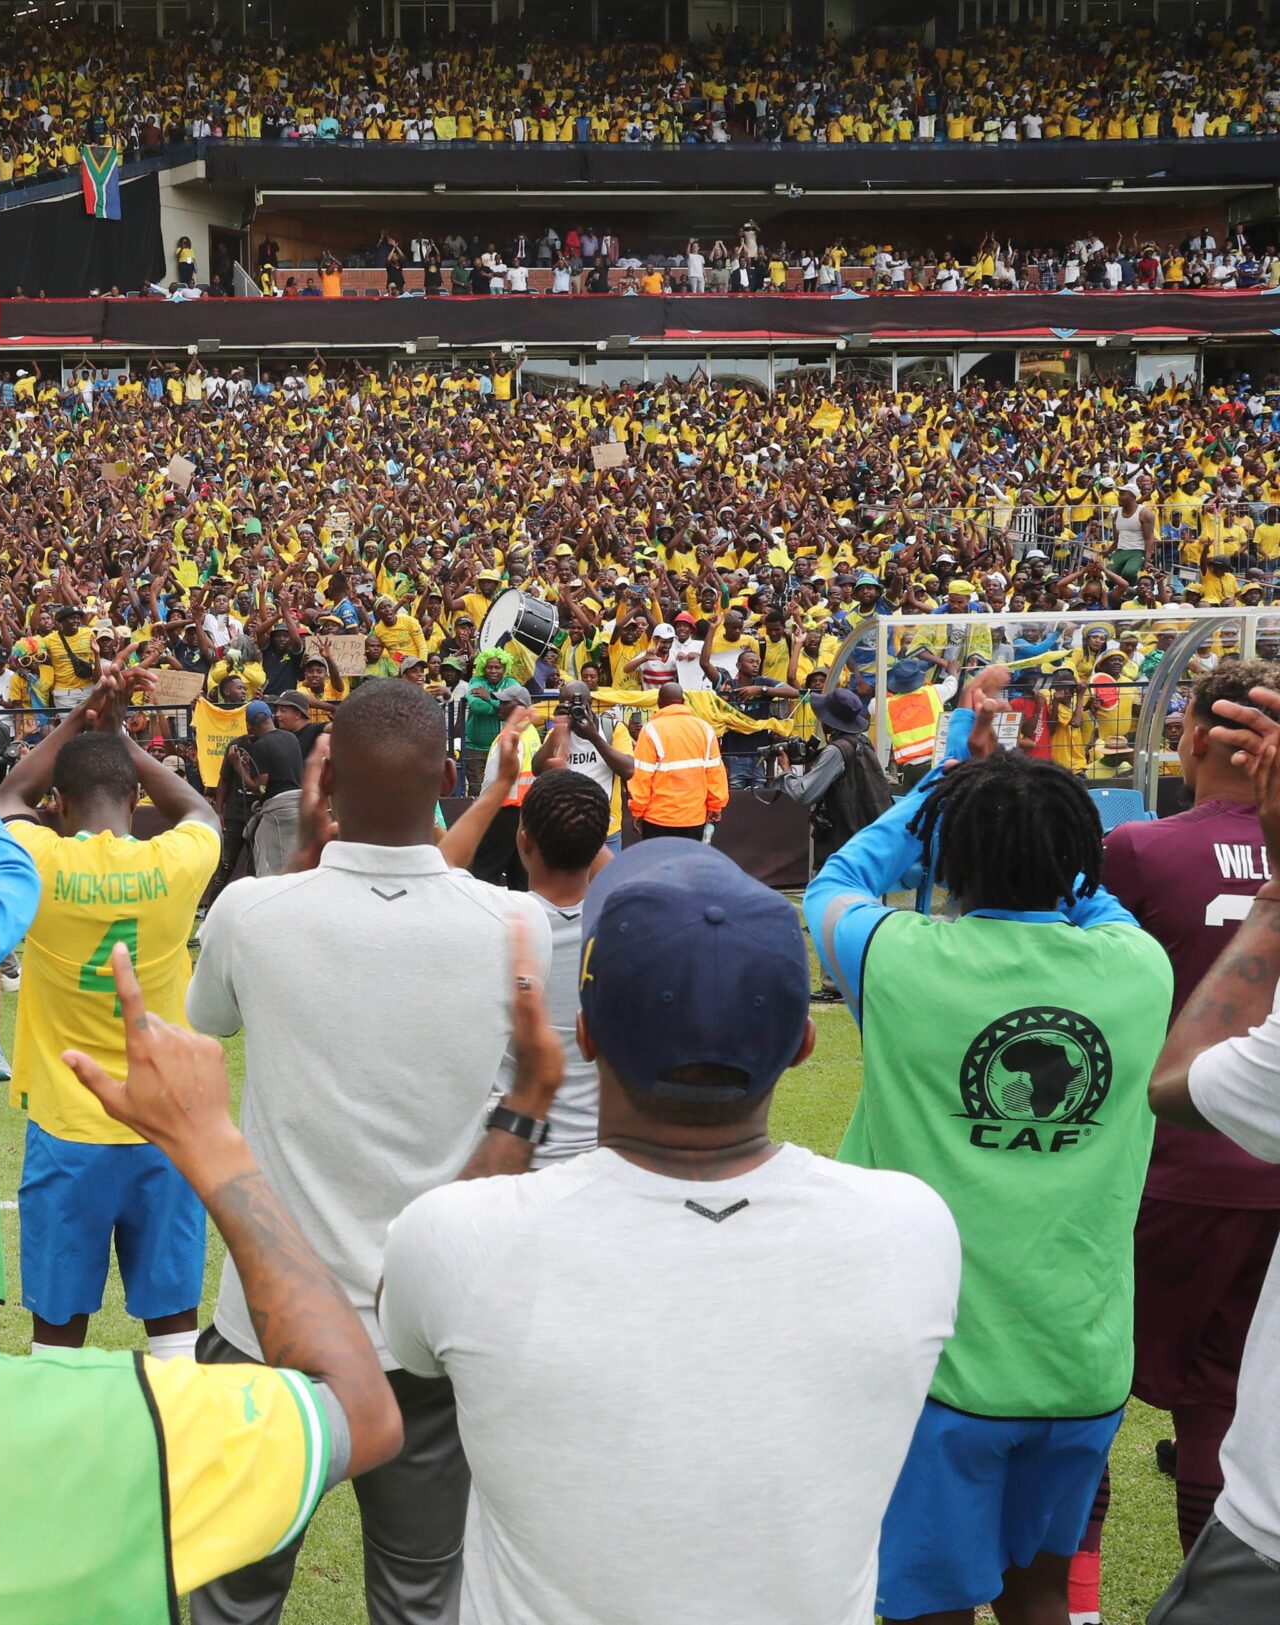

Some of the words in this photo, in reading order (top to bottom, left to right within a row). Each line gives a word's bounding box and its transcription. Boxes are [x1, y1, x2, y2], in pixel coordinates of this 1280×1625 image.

[207, 734, 238, 742] 2013/20
[54, 866, 168, 904] MOKOENA
[79, 918, 138, 1018] 4
